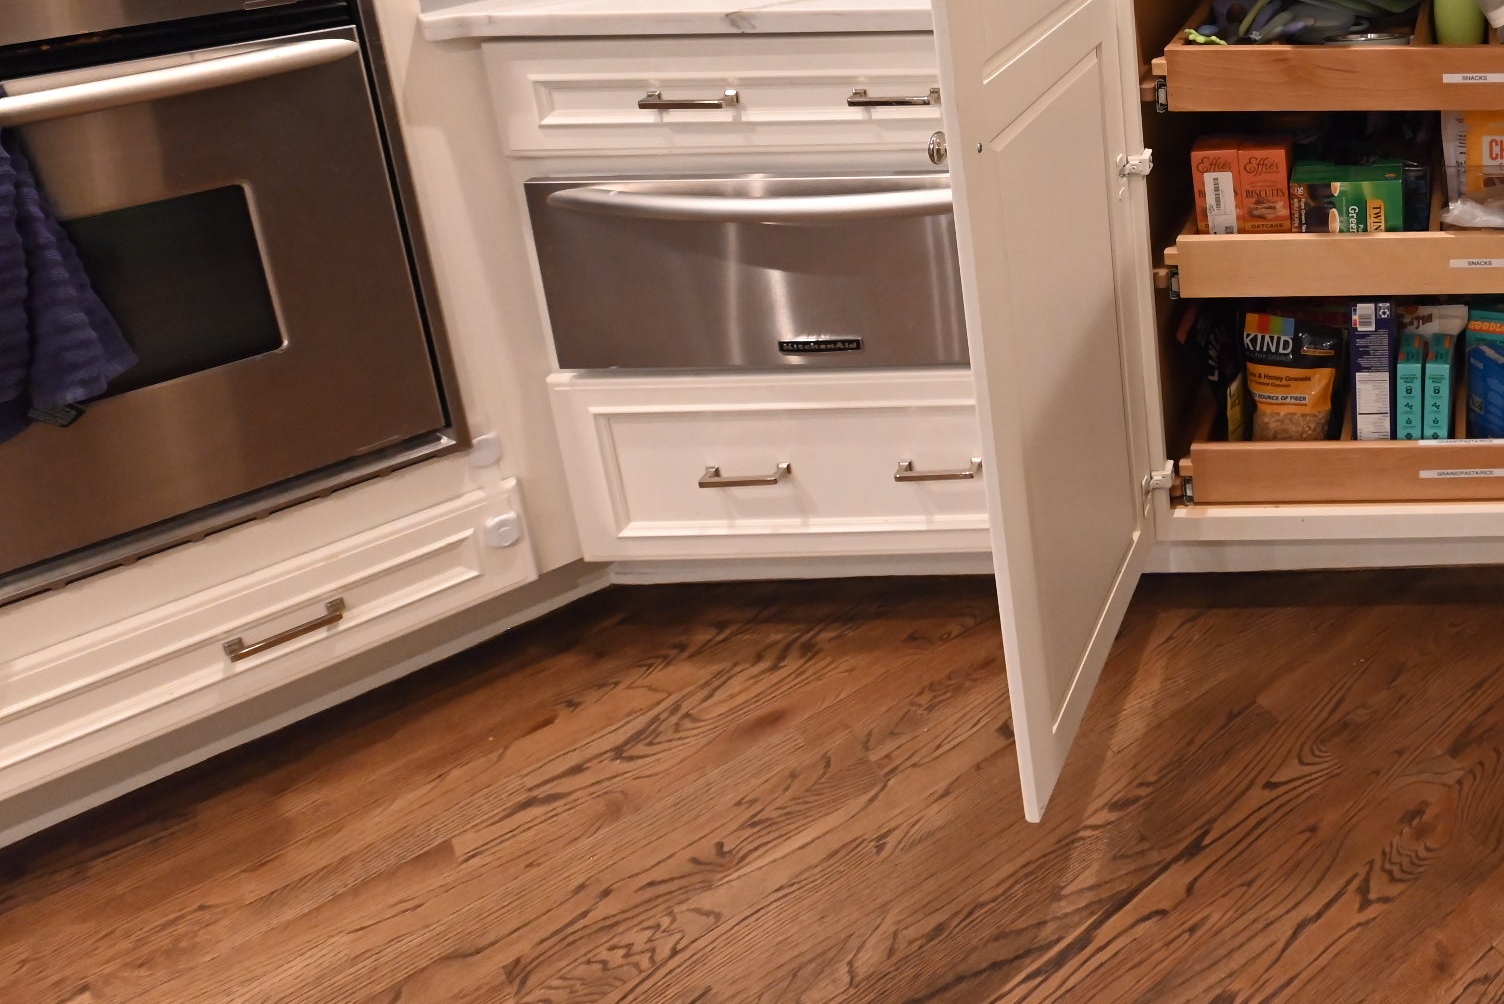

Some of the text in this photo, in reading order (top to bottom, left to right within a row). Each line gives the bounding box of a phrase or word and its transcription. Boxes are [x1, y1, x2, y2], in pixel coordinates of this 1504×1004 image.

[1245, 188, 1285, 199] BISCUITS
[783, 341, 857, 351] KitchenAid
[1243, 332, 1293, 354] KIND
[1263, 373, 1284, 383] Honey
[1257, 393, 1278, 401] SOURCE
